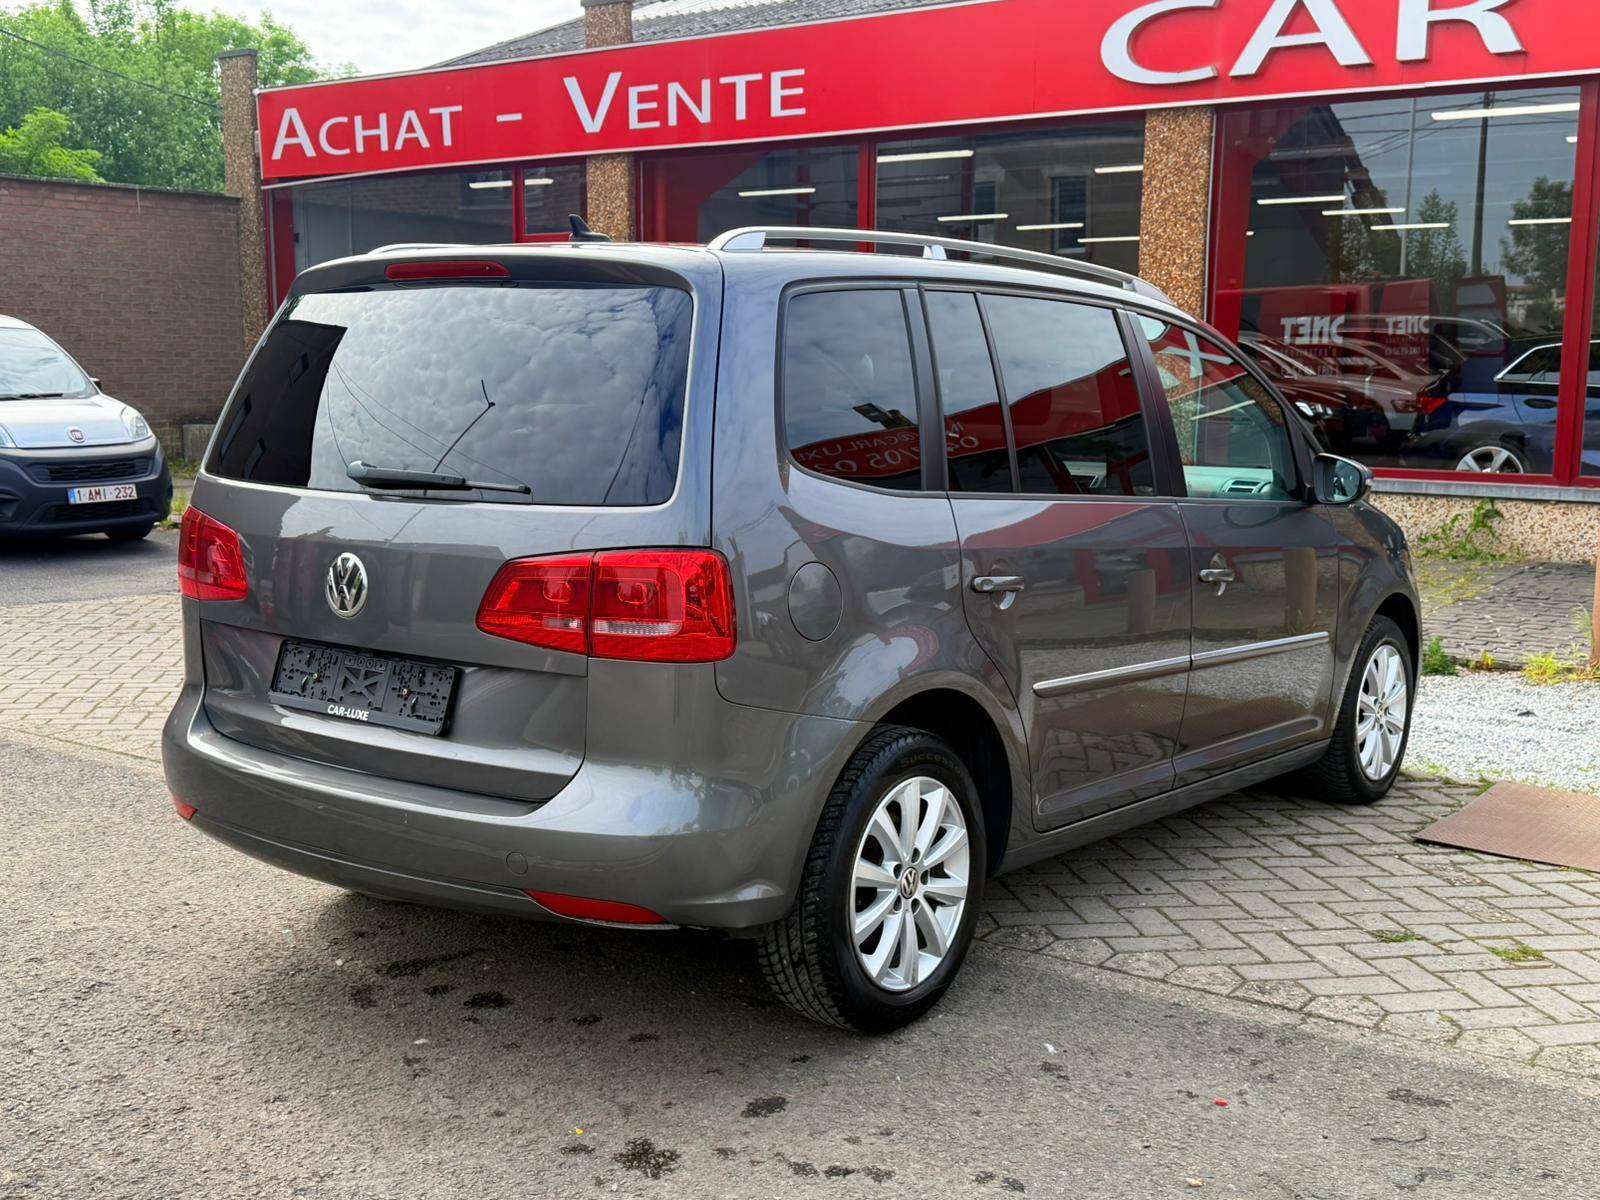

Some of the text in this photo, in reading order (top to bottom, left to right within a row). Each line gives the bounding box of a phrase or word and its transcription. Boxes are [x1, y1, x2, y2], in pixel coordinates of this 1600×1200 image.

[1101, 0, 1525, 85] CAR
[271, 104, 463, 160] ACHAT
[563, 69, 806, 133] VENTE
[327, 704, 370, 721] CAR-LUXE
